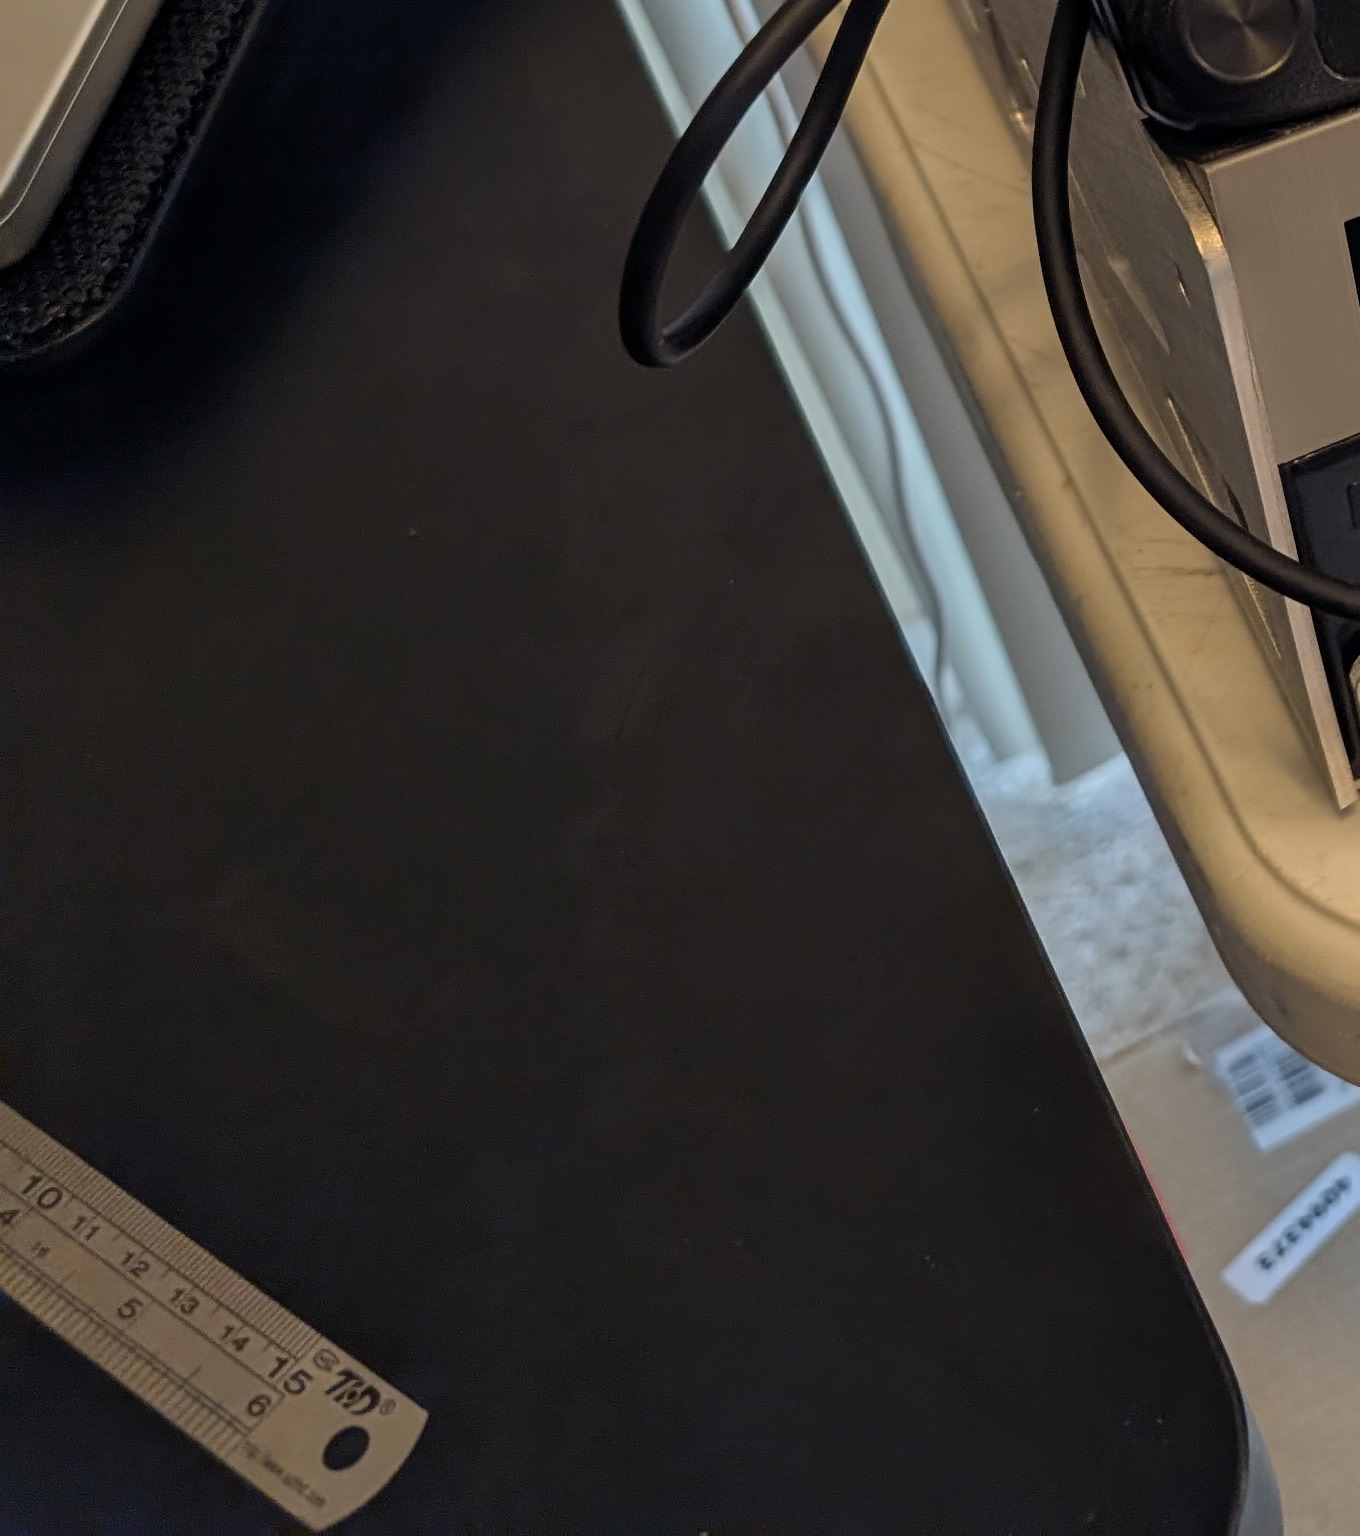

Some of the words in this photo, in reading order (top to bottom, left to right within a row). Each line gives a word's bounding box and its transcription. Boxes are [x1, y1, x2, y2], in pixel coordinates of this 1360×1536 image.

[22, 1174, 63, 1210] 10
[73, 1214, 101, 1241] 11
[120, 1250, 151, 1279] 12
[169, 1287, 199, 1315] 13
[221, 1324, 251, 1352] 14
[268, 1356, 315, 1396] 15
[116, 1296, 145, 1321] 5
[246, 1393, 273, 1419] 6
